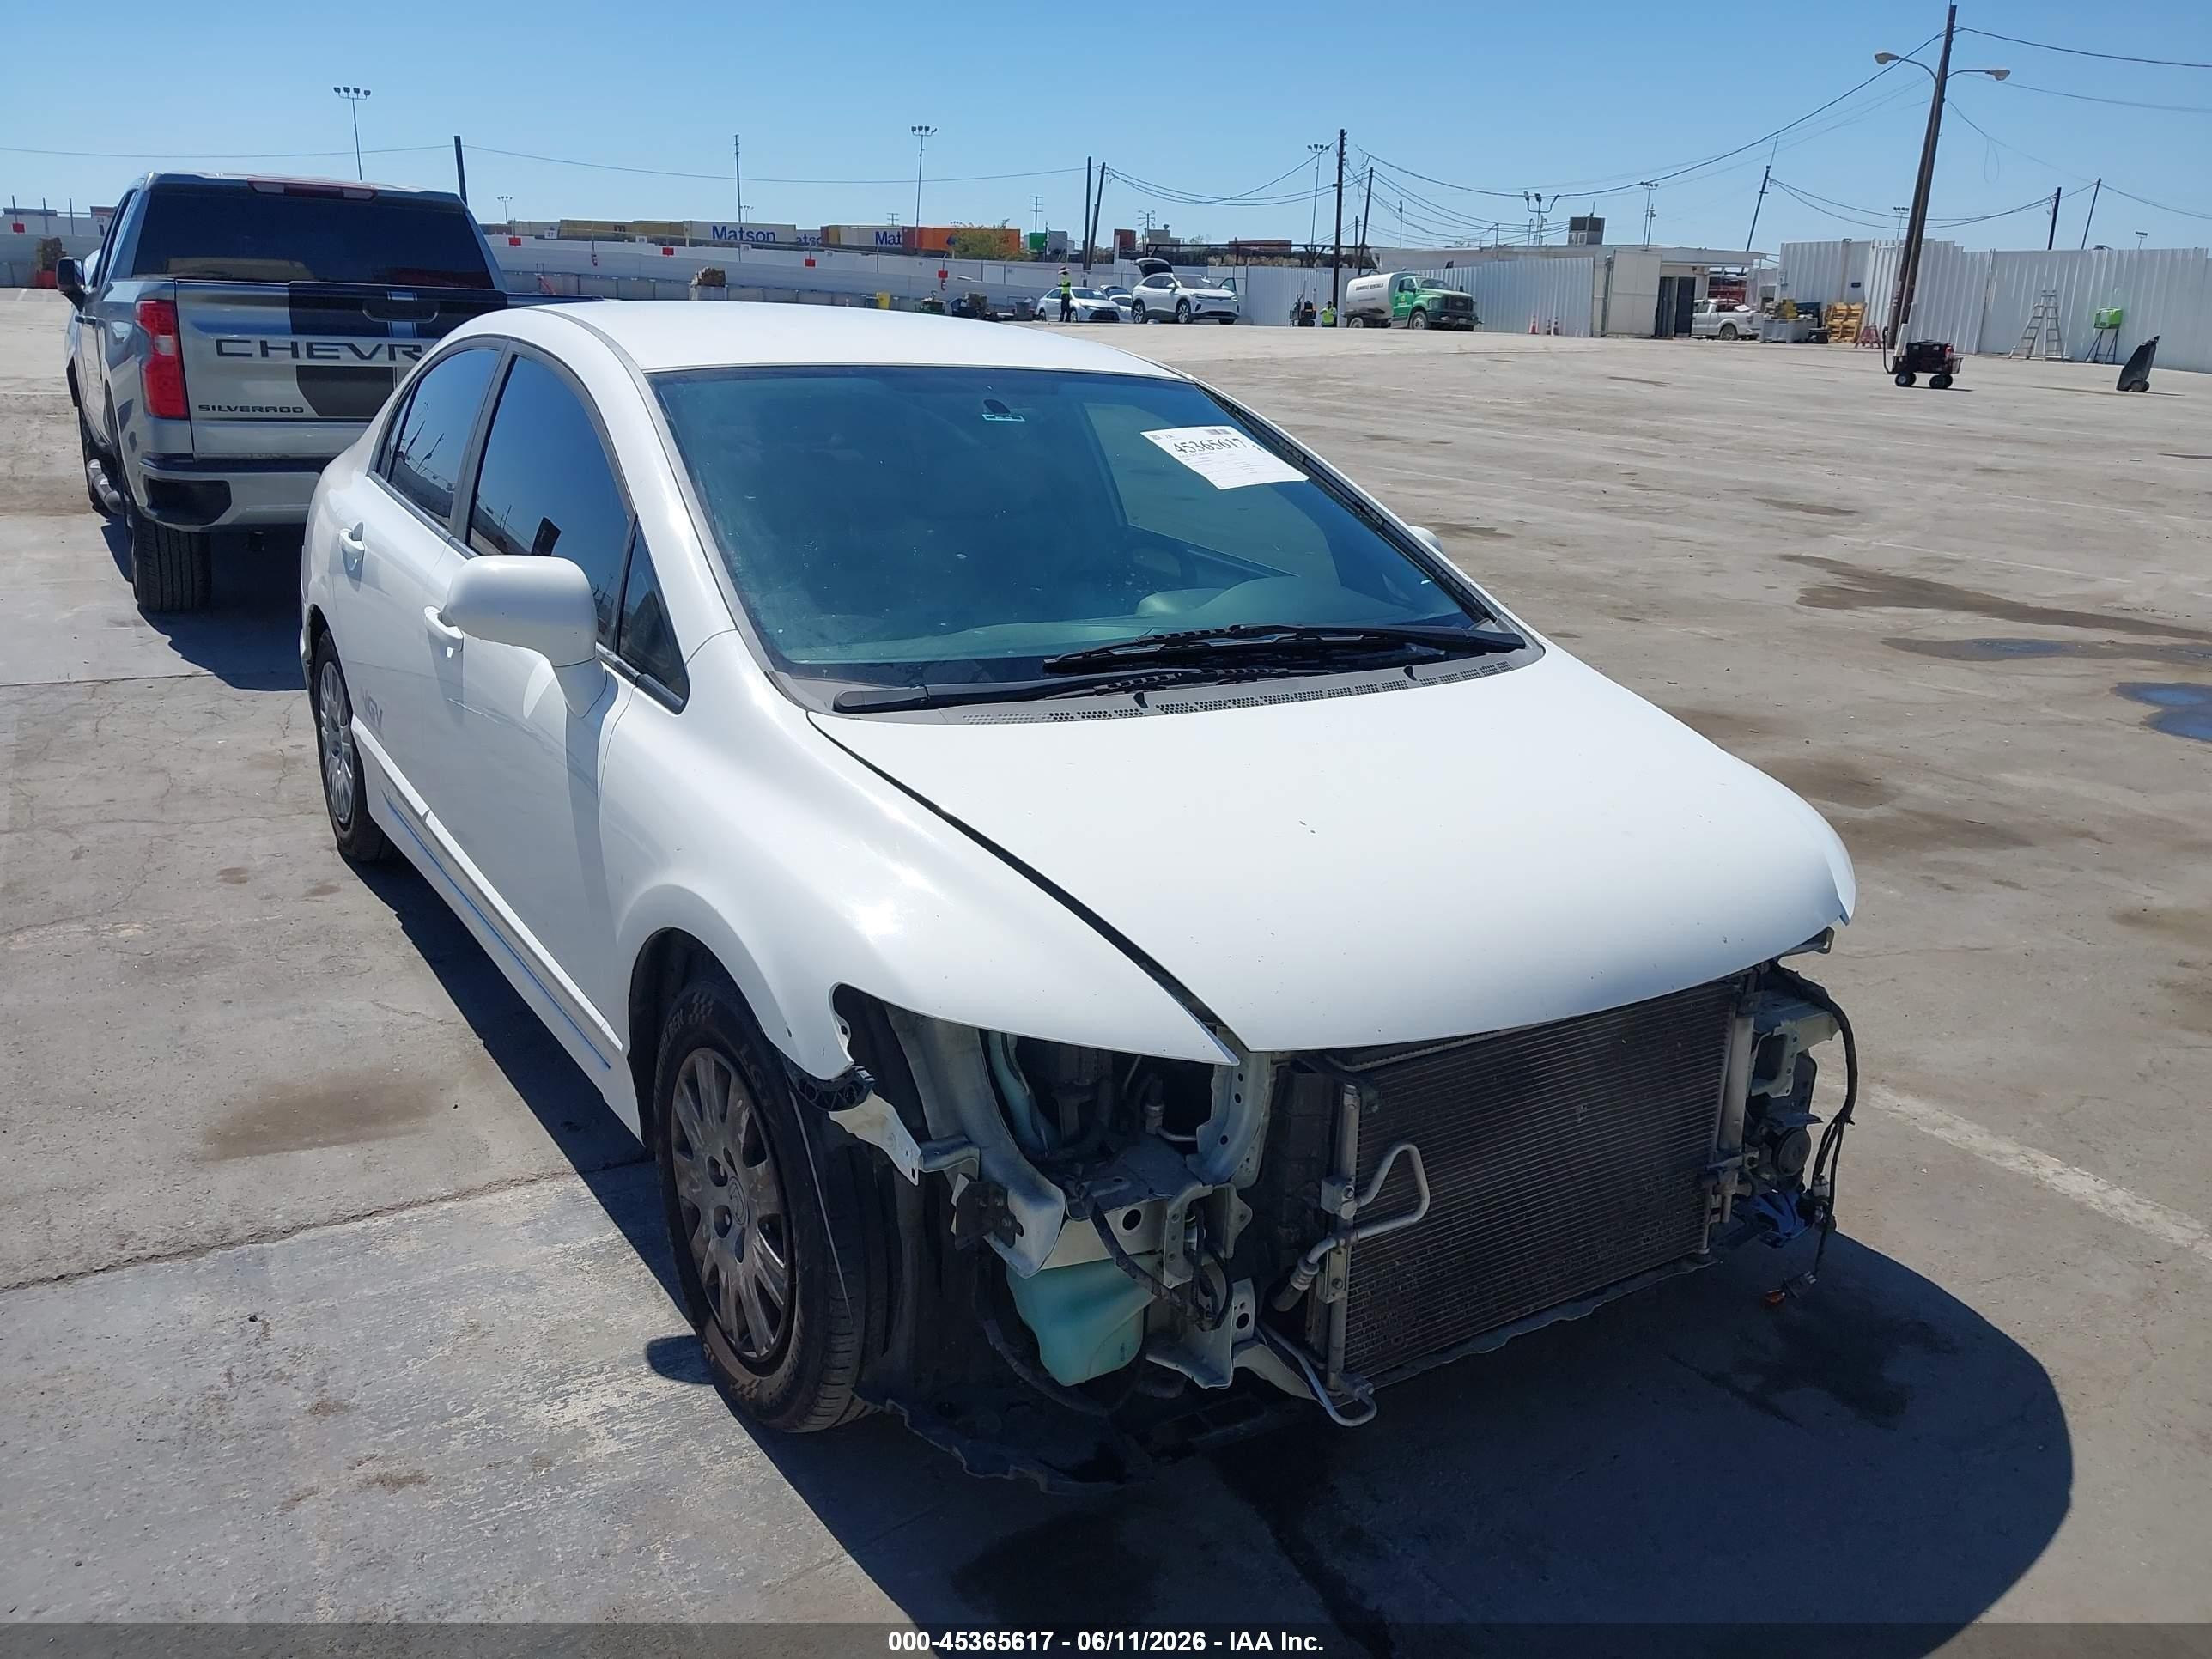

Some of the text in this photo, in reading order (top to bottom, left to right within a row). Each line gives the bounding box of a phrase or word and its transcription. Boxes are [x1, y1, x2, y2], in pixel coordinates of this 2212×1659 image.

[712, 225, 776, 243] Matson
[875, 231, 902, 246] Mat
[198, 404, 304, 414] SILVERADO
[1173, 438, 1247, 453] 45365617
